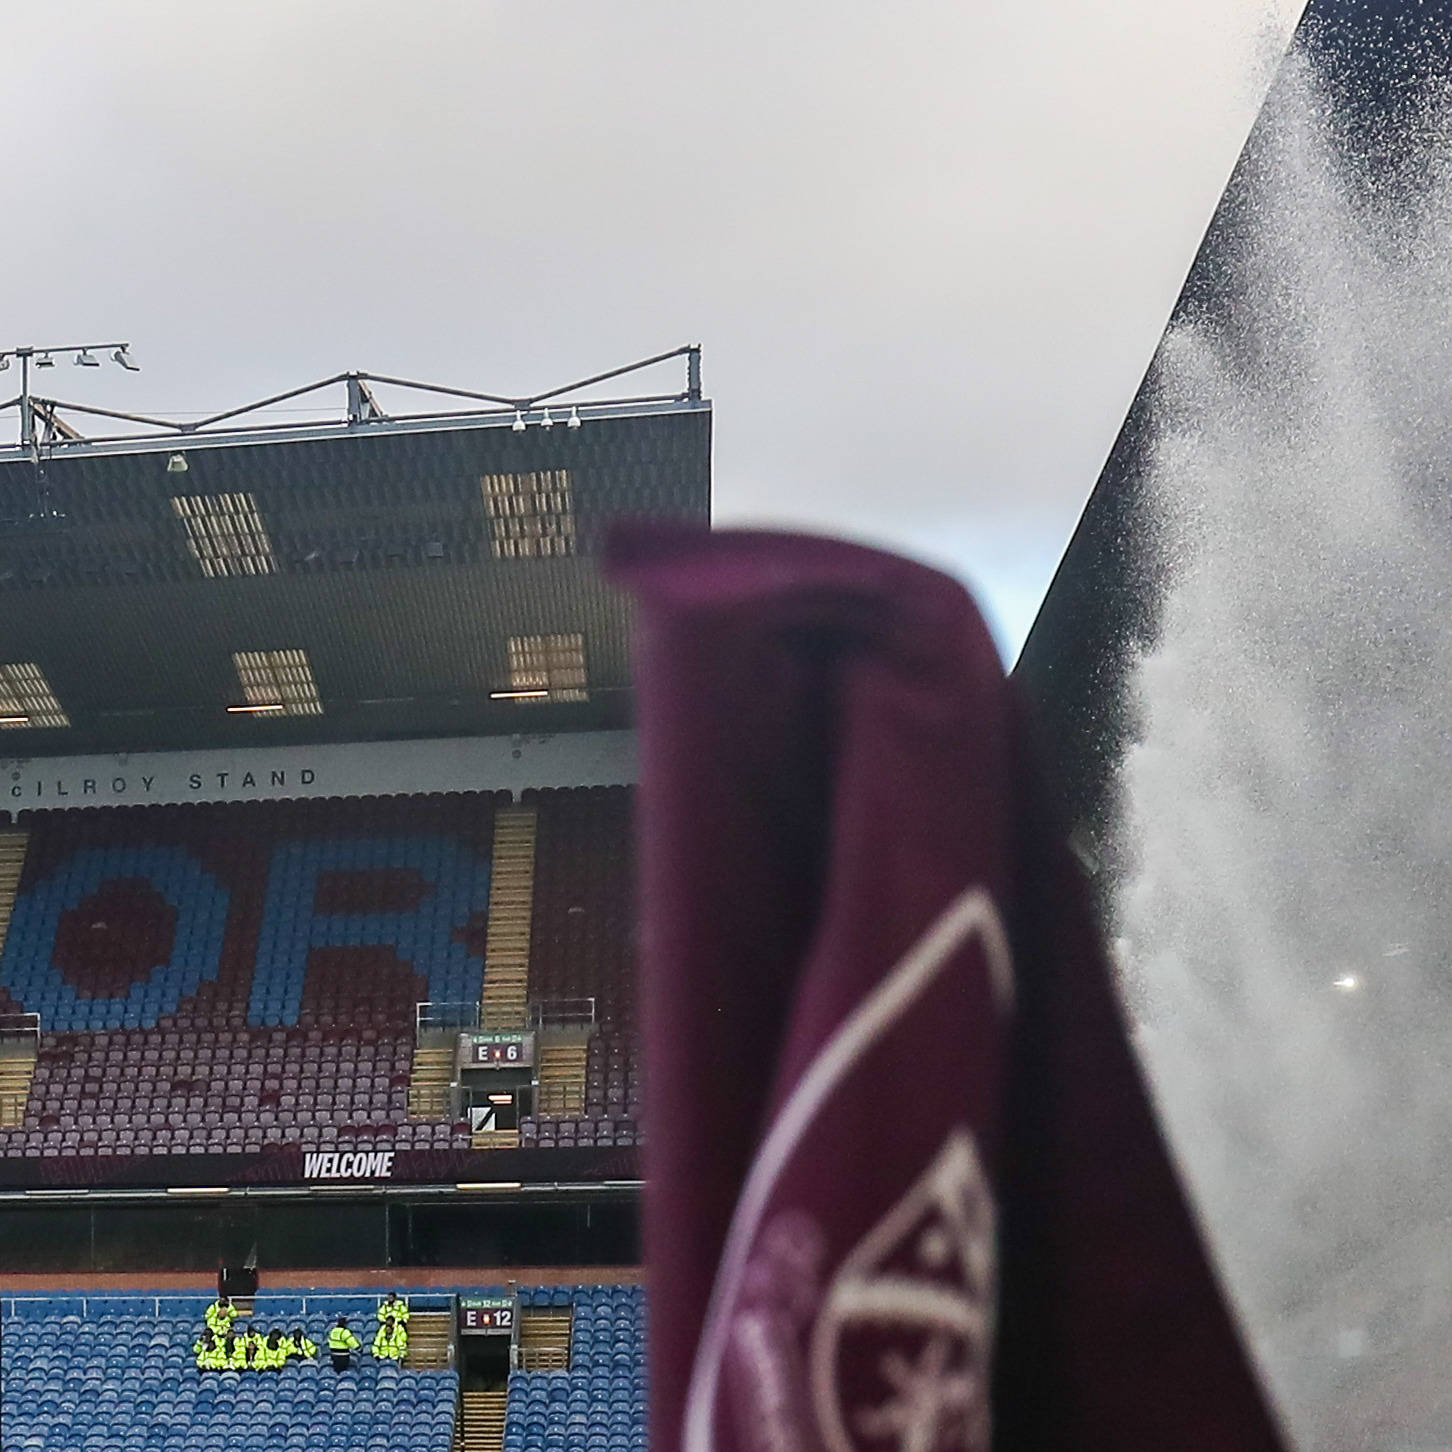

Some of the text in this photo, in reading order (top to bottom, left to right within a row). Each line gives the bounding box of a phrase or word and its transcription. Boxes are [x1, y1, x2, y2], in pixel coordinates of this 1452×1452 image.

[189, 768, 317, 791] STAND
[478, 1045, 517, 1060] E 6
[303, 1151, 395, 1180] WELCOME
[467, 1310, 512, 1326] E 12
